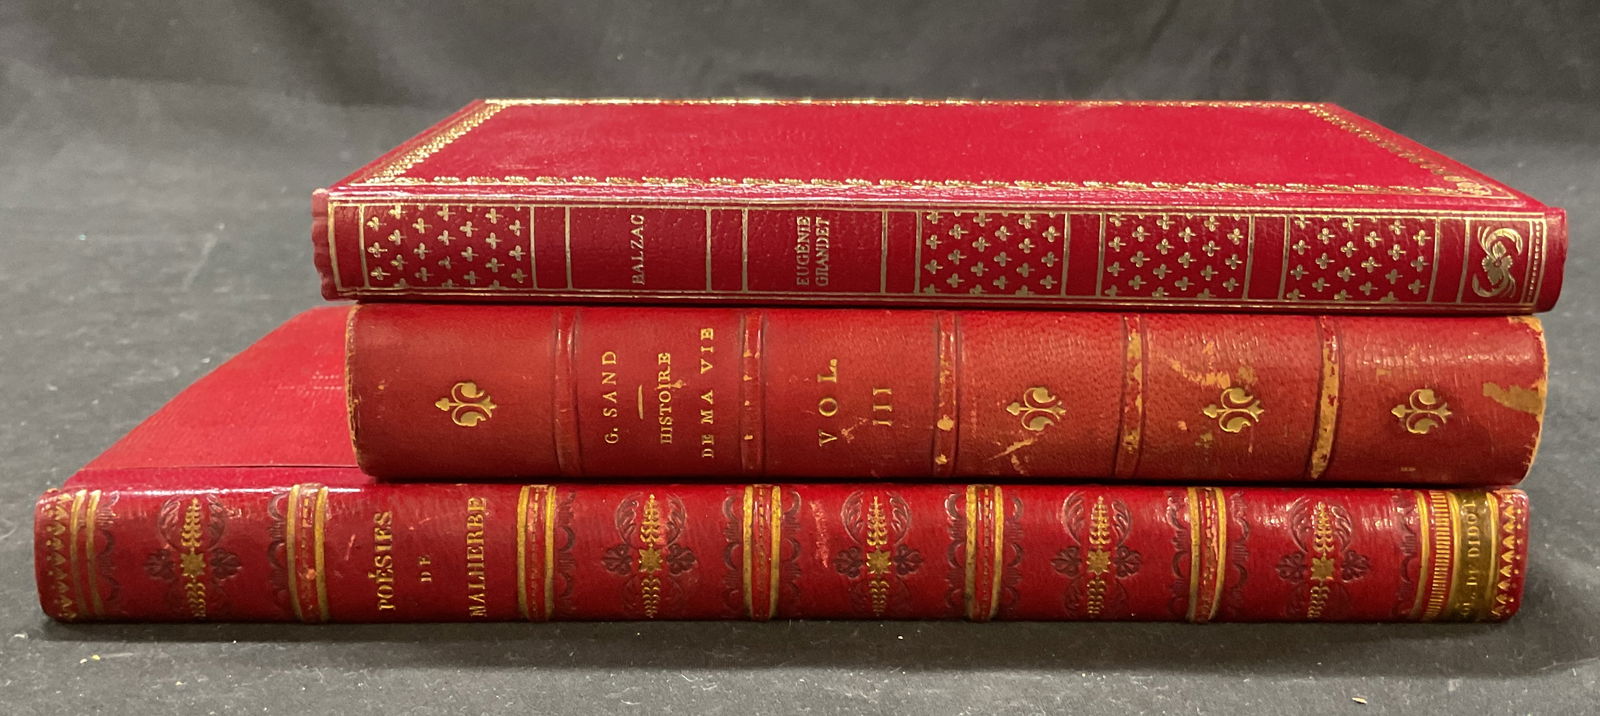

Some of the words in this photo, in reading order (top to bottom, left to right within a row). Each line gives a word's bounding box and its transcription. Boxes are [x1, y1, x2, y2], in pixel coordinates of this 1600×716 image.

[630, 214, 645, 285] BALZAC
[794, 216, 811, 286] EUGÉNIE
[815, 217, 830, 286] GRANDET
[602, 351, 617, 418] SAND
[700, 328, 714, 374] VIE
[658, 352, 673, 444] HISTOIRE
[701, 390, 714, 424] MA
[817, 358, 839, 447] VOL.
[873, 387, 892, 426] III
[604, 427, 619, 444] G.
[702, 434, 714, 458] DE
[367, 510, 396, 611] POÉSIES
[467, 497, 487, 616] MALHERBE
[1463, 500, 1480, 557] DIDOT
[419, 555, 432, 582] DE
